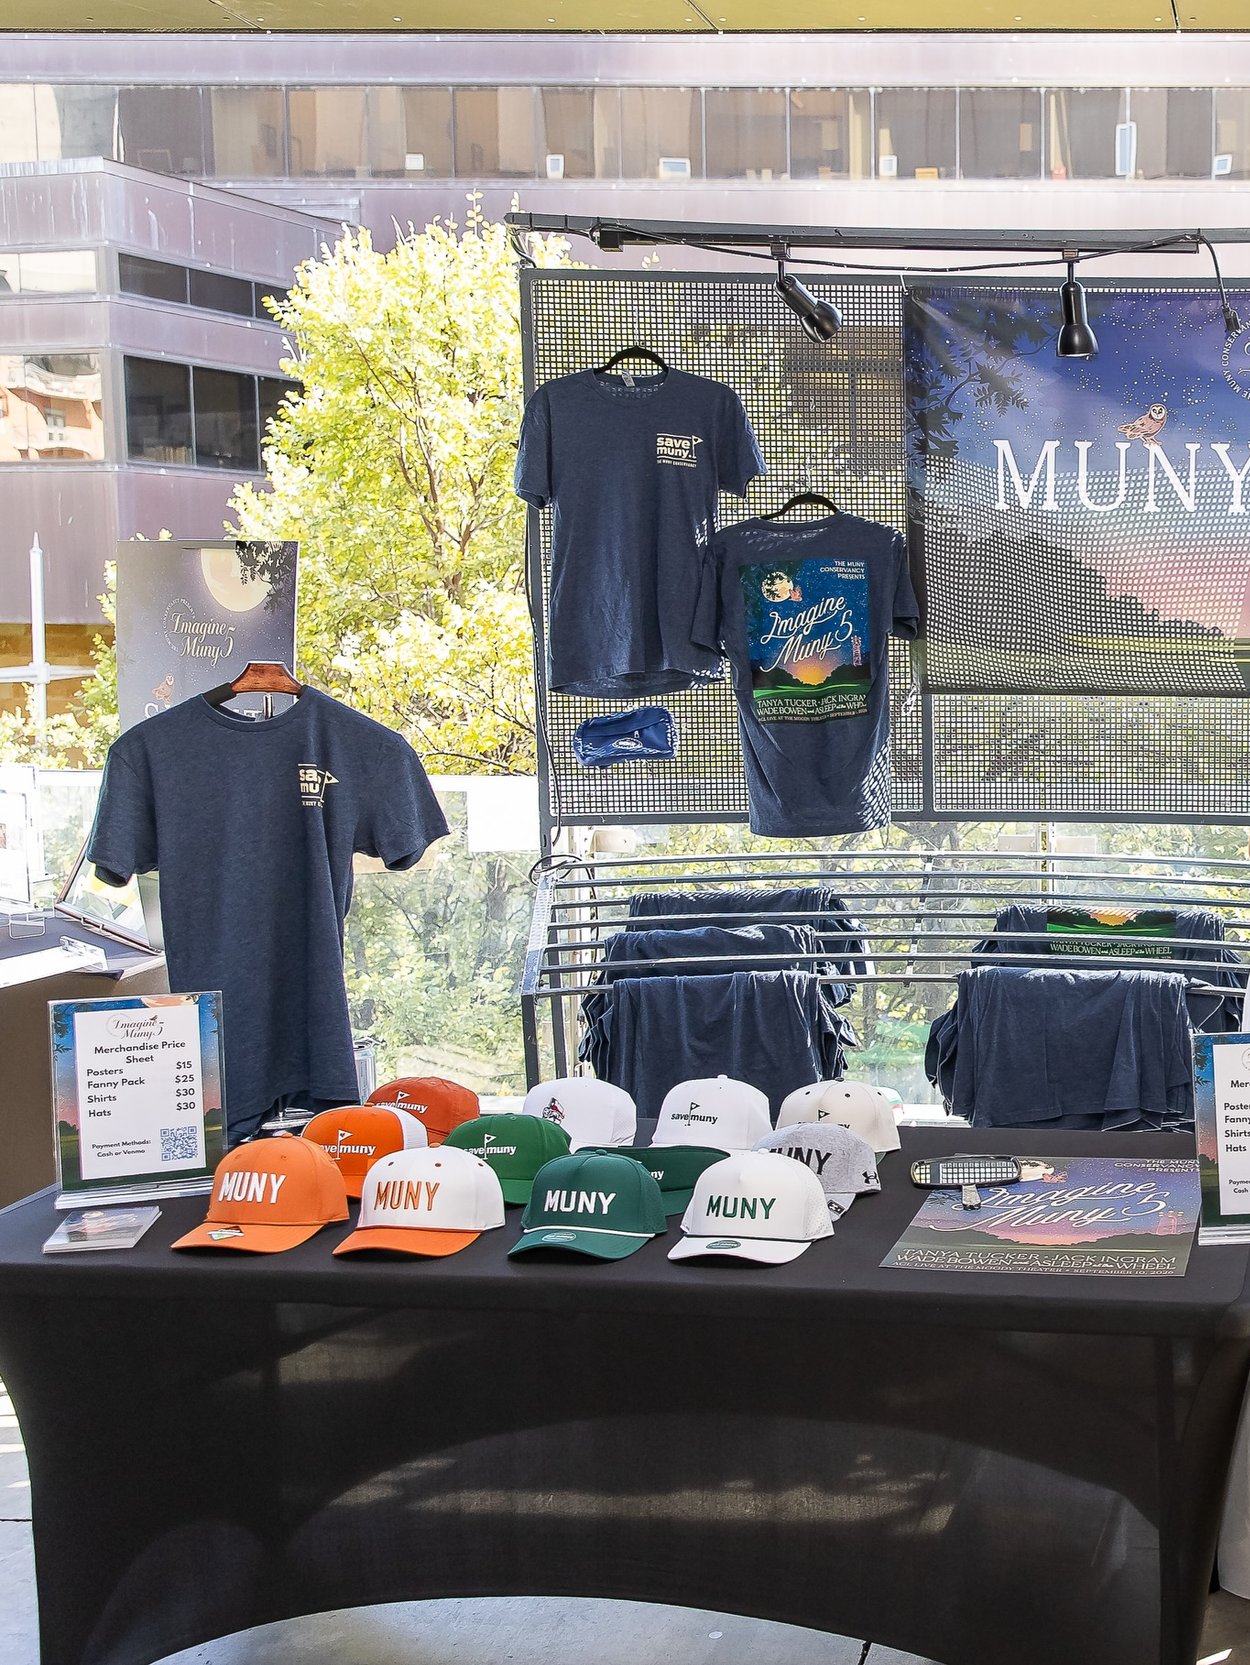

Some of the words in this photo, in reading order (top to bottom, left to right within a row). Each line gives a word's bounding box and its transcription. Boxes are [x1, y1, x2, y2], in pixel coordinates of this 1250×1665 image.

[1223, 370, 1240, 392] MUNY
[657, 437, 690, 449] save
[657, 447, 691, 458] muny.
[170, 612, 226, 642] Imagine
[761, 597, 845, 644] Imagine
[180, 636, 221, 666] Muny
[220, 627, 236, 657] 5
[760, 632, 841, 672] Muny
[835, 610, 853, 641] 5
[758, 699, 783, 707] TANYA
[784, 699, 817, 707] TUCKER
[757, 707, 779, 715] WADE
[779, 707, 808, 715] BOWEN
[1050, 943, 1073, 952] WADE
[1073, 944, 1101, 955] BOWEN
[1109, 948, 1136, 956] ASLEEP
[1145, 947, 1172, 955] WHEEL
[94, 1042, 159, 1054] Merchandise
[162, 1041, 186, 1049] Price
[126, 1056, 154, 1064] Sheet
[87, 1068, 123, 1076] Posters
[176, 1061, 192, 1069] $15
[88, 1080, 118, 1089] Fanny
[122, 1077, 145, 1086] Pack
[175, 1075, 195, 1083] $25
[87, 1095, 117, 1103] Shirts
[175, 1088, 195, 1097] $30
[89, 1109, 112, 1118] Hats
[176, 1102, 196, 1111] $30
[398, 1102, 428, 1114] muny
[671, 1113, 689, 1121] save
[691, 1114, 718, 1125] muny
[1224, 1130, 1250, 1138] Shirts
[92, 1142, 120, 1150] Payment
[122, 1139, 151, 1147] Methods:
[339, 1144, 376, 1156] muny
[486, 1145, 517, 1155] muny
[1226, 1144, 1247, 1152] Hats
[218, 1172, 286, 1203] MUNY
[374, 1181, 440, 1211] MUNY
[544, 1190, 616, 1214] MUNY
[706, 1195, 776, 1220] MUNY
[929, 1207, 1129, 1232] Muny
[1121, 1191, 1171, 1216] 5
